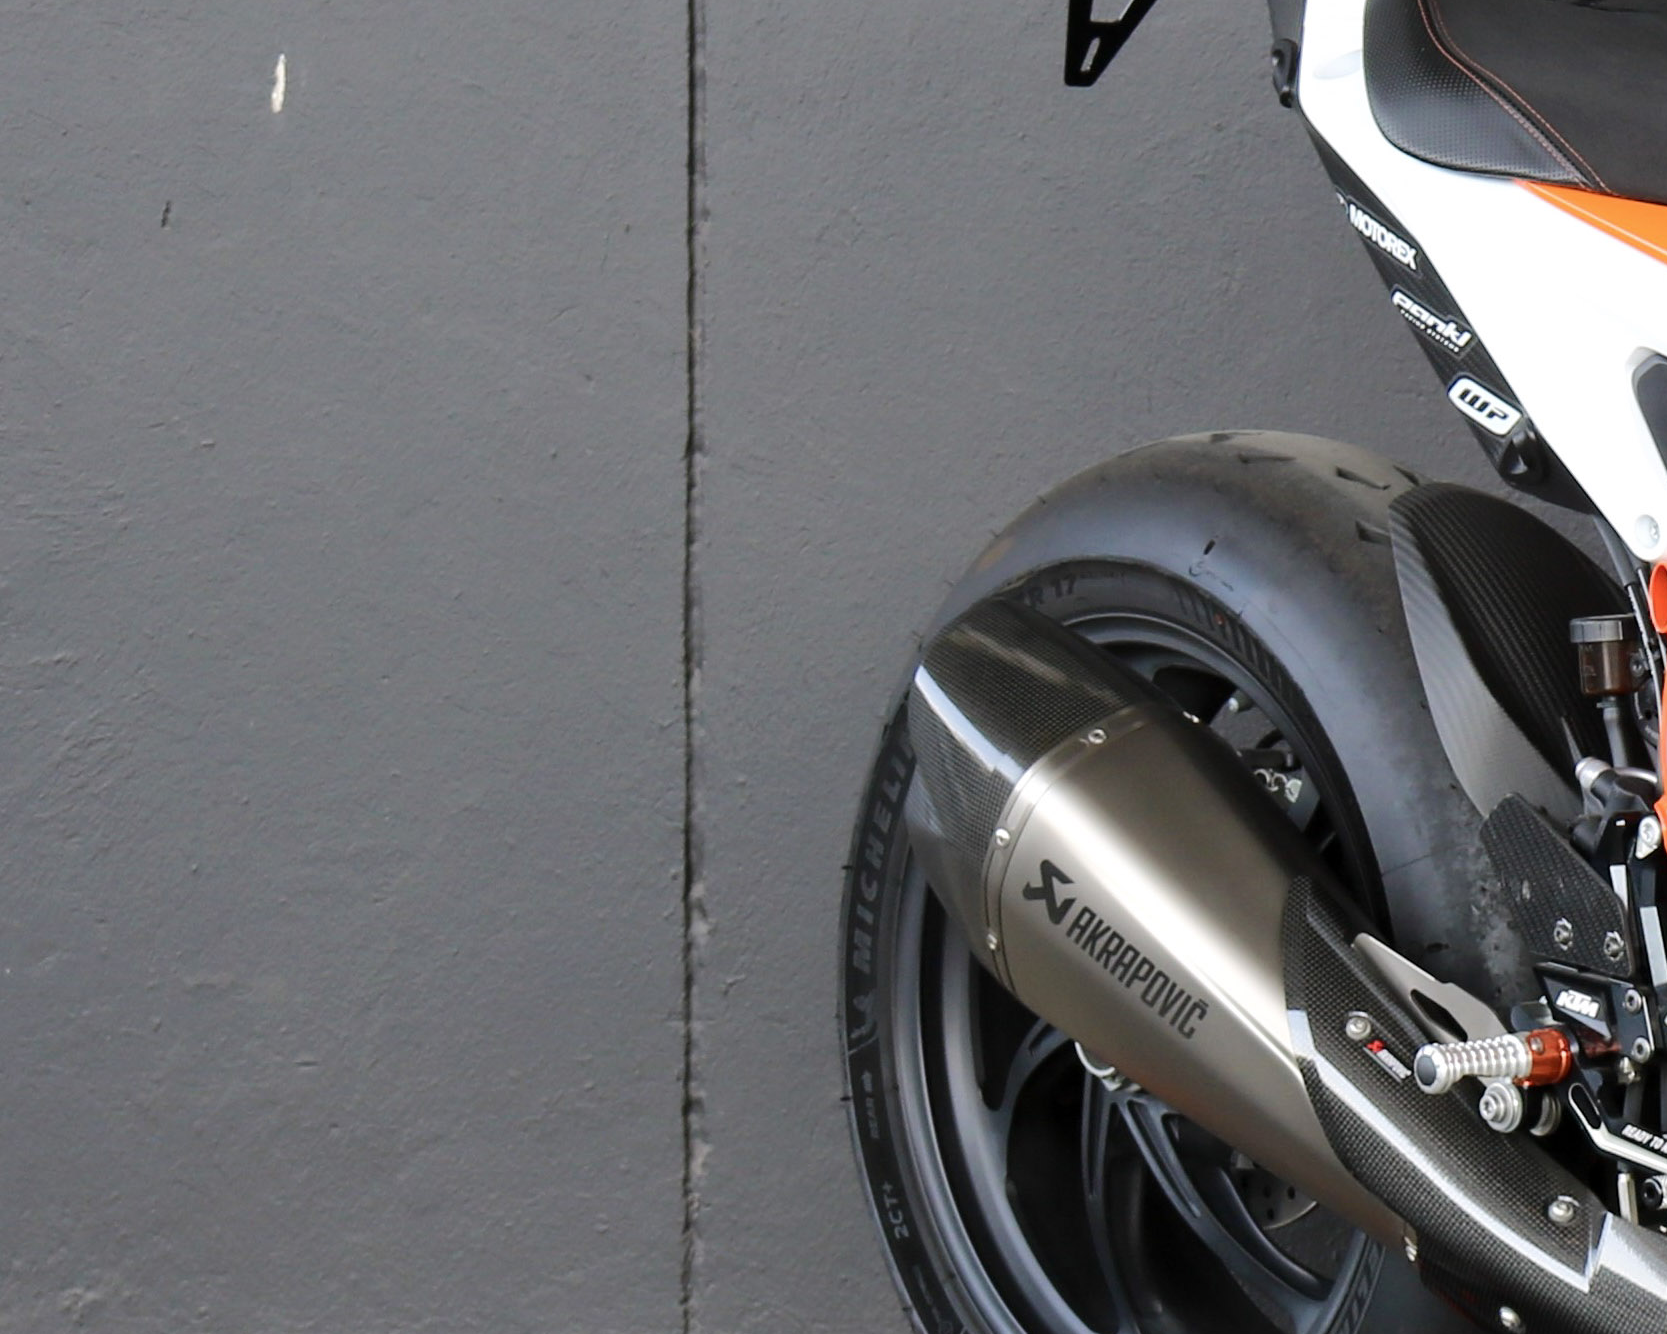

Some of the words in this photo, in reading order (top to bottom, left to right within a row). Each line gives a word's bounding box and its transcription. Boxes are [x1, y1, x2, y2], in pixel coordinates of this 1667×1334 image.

[1349, 203, 1417, 270] MOTOREX
[1458, 388, 1509, 420] WP
[1065, 905, 1210, 1040] AKRAPOVIČ
[1555, 989, 1600, 1019] KTM
[1621, 1123, 1653, 1145] READY
[1649, 1135, 1665, 1150] TO
[880, 1180, 911, 1241] 2CT+
